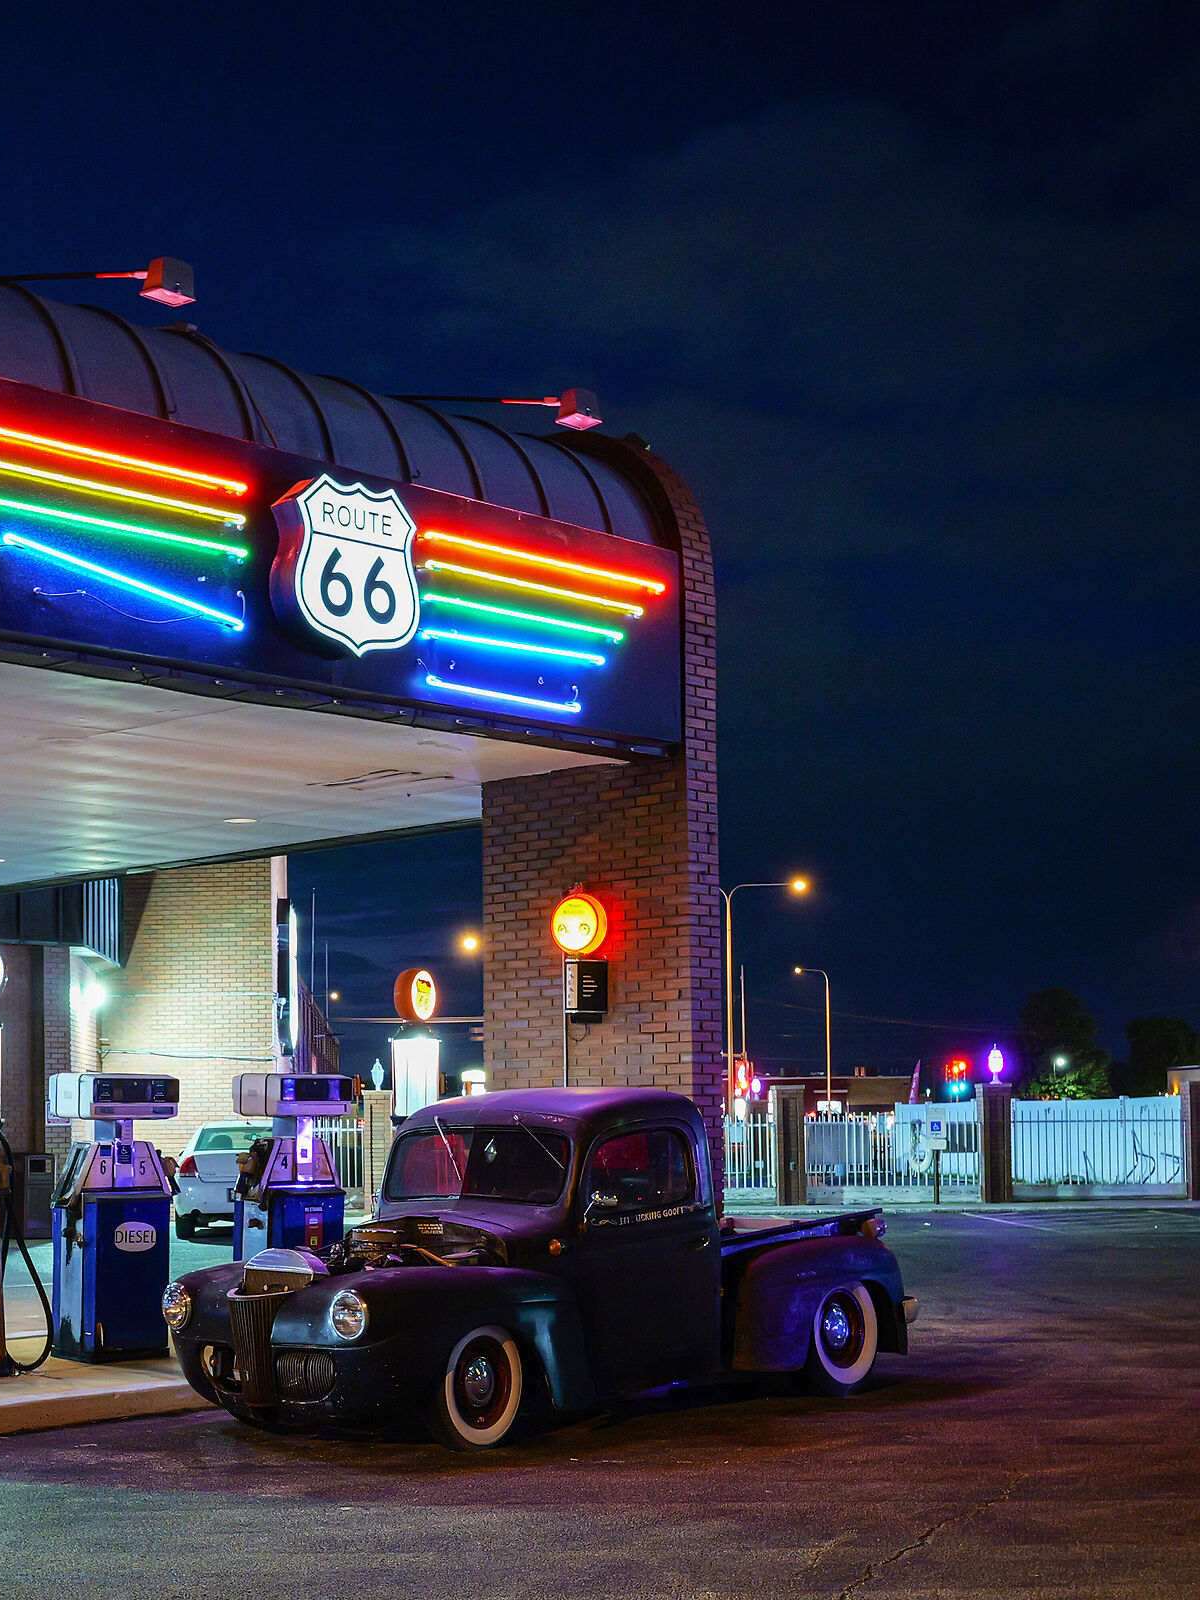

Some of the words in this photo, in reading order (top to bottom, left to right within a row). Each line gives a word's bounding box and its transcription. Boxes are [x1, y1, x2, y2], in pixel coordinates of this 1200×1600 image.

[322, 501, 393, 537] ROUTE
[320, 547, 396, 625] 66
[100, 1159, 107, 1175] 6
[139, 1160, 146, 1176] 5
[281, 1155, 288, 1169] 4
[115, 1230, 156, 1244] DIESEL
